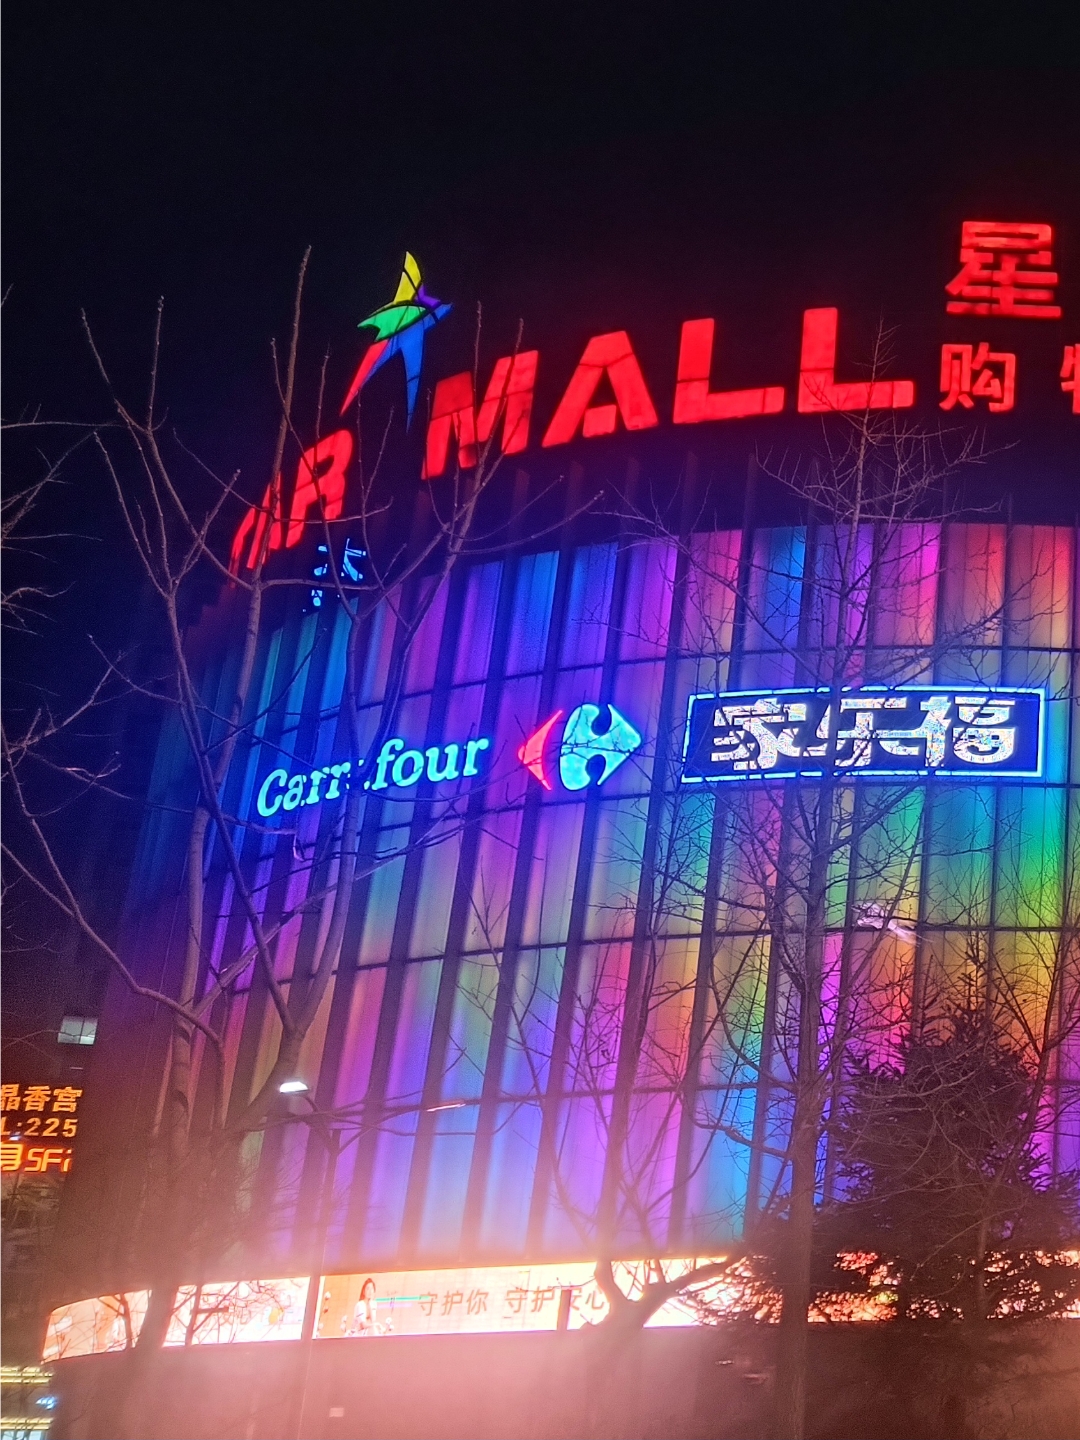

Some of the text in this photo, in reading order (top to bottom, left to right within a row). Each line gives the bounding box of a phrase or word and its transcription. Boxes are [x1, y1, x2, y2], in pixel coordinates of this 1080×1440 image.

[421, 306, 915, 480] MALL
[710, 696, 1016, 771] 家乐福
[257, 738, 490, 817] Carrfour
[418, 1288, 490, 1317] 守护你
